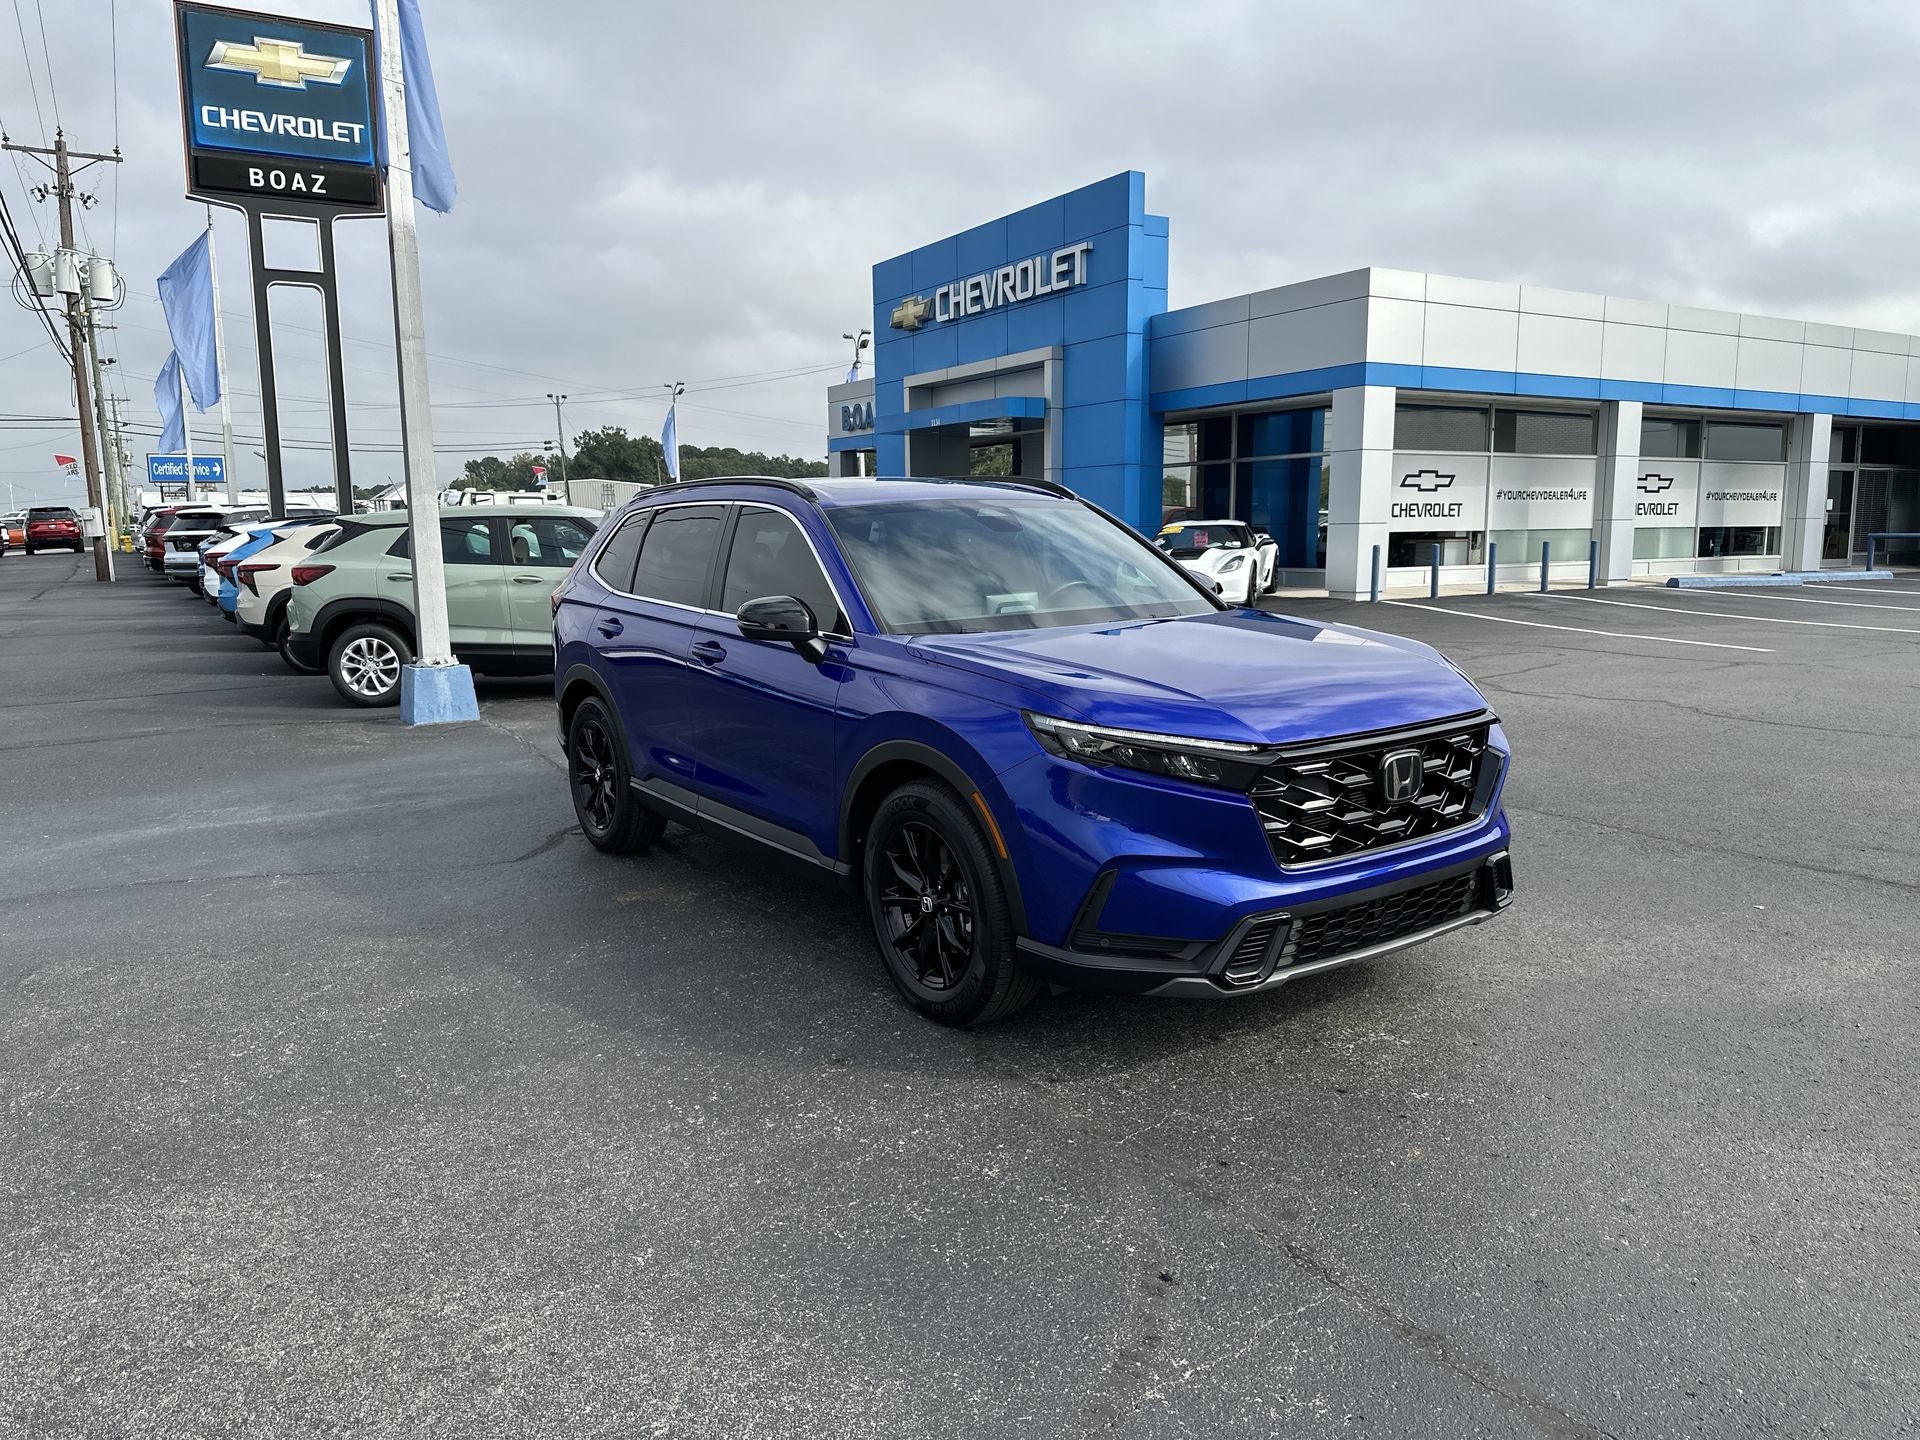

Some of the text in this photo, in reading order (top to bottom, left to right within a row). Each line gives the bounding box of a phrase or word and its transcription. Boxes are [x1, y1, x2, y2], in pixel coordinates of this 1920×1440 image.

[201, 105, 364, 144] CHEVROLET
[249, 167, 327, 194] BOAZ
[935, 241, 1093, 323] CHEVROLET
[842, 402, 874, 431] BOA
[153, 463, 210, 475] Certified Srvice
[1496, 488, 1587, 501] #YOURCHEVYDEALER4LIFE
[1706, 489, 1777, 501] #YOURCHEVYDEALER4LIFE
[1391, 503, 1463, 518] CHEVROLET
[1635, 503, 1679, 516] EVROLET
